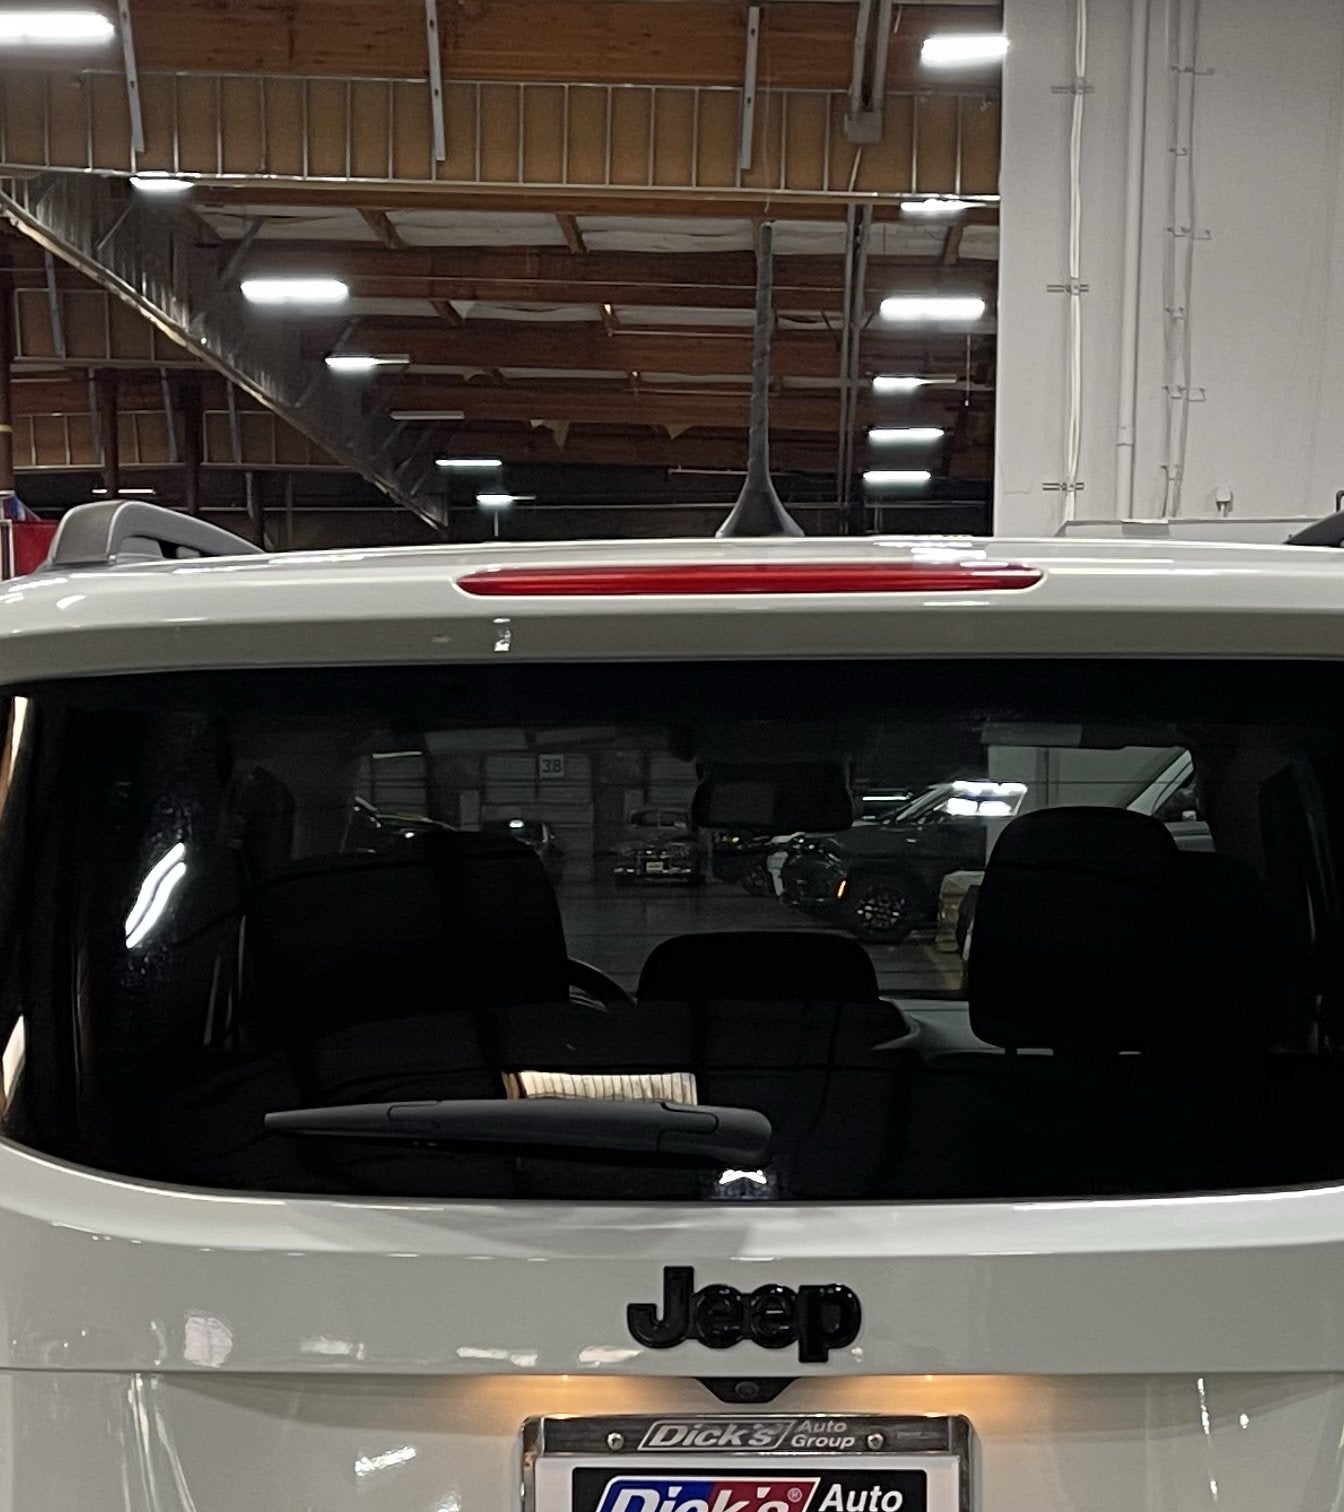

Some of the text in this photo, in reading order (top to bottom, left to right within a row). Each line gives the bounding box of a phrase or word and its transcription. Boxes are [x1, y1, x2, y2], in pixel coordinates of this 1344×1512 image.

[627, 1266, 861, 1362] Jeep
[648, 1424, 774, 1446] Dick's
[797, 1420, 847, 1433] Auto
[791, 1434, 856, 1449] Group
